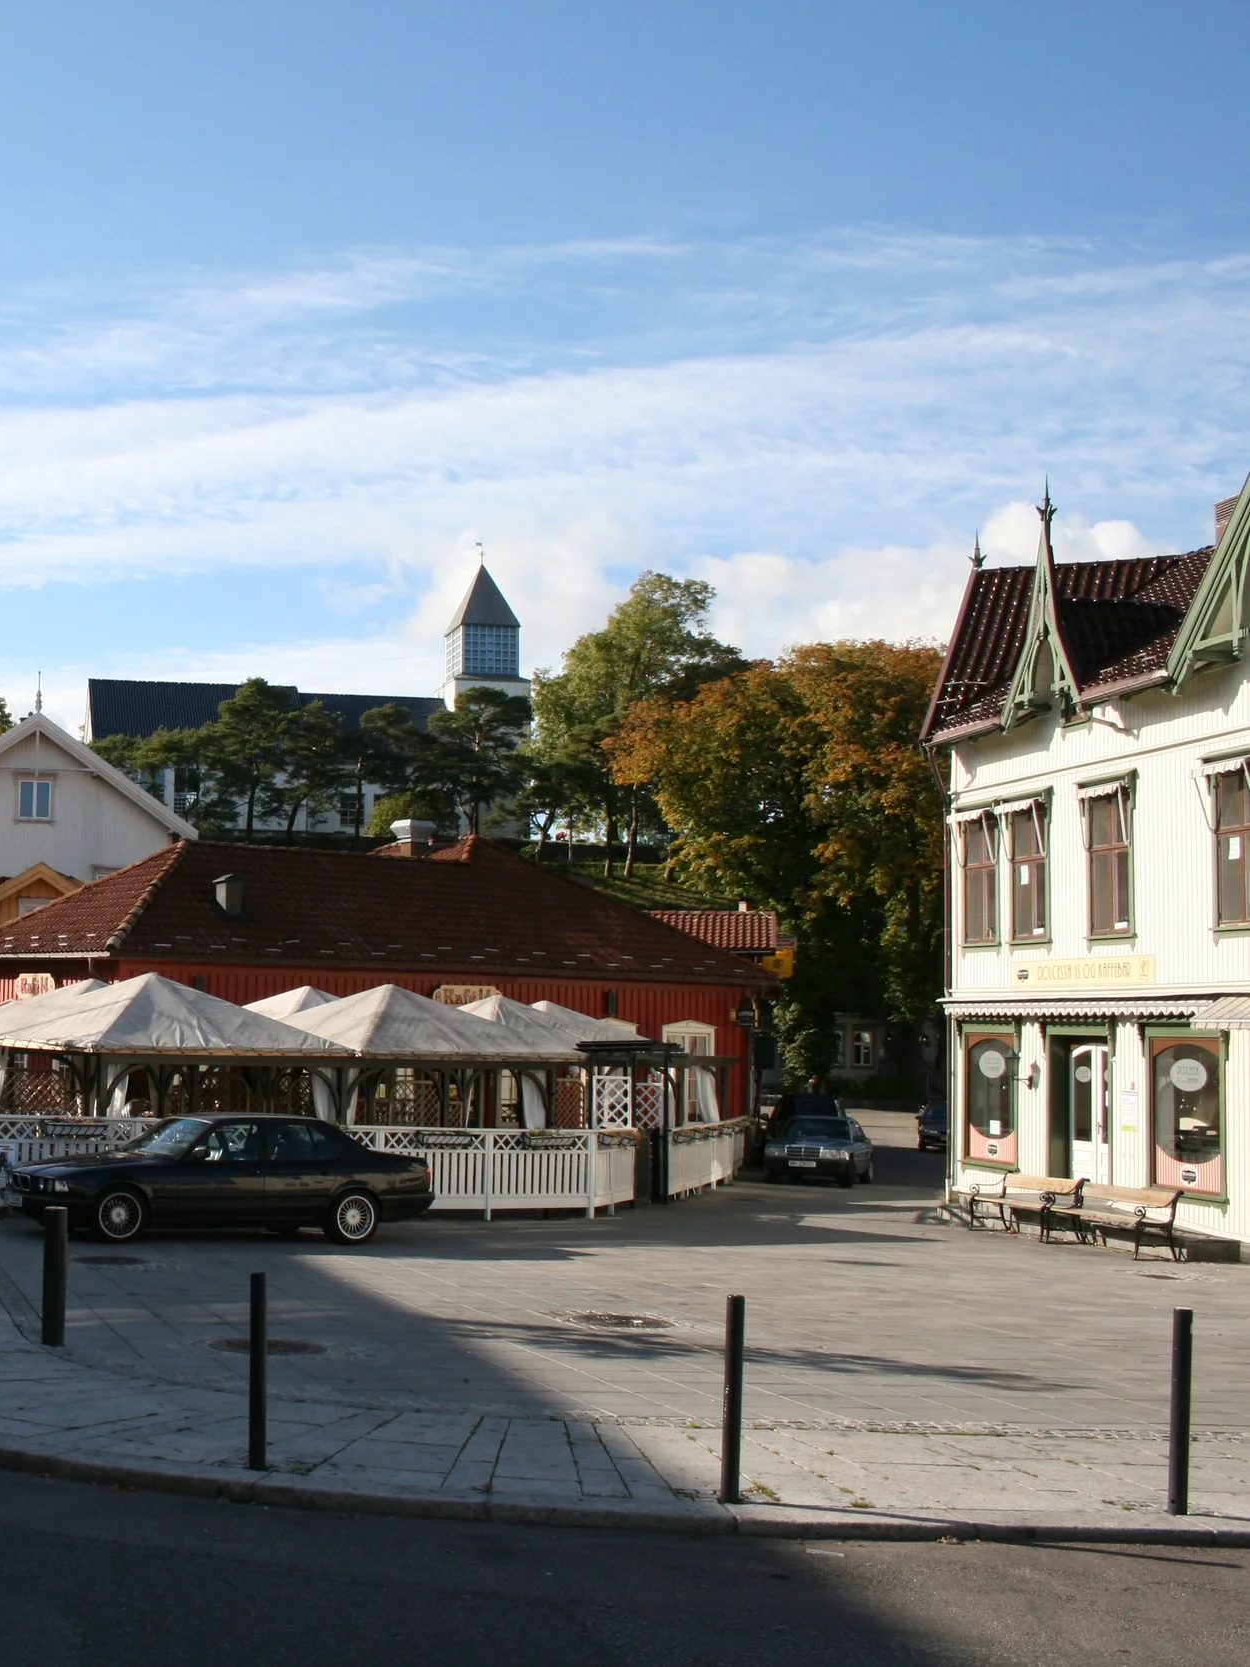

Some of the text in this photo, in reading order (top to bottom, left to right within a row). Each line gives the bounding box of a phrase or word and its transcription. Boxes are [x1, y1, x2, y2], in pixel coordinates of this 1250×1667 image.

[1037, 964, 1072, 981] DOLCESSA
[1074, 964, 1081, 979] IS
[1083, 963, 1096, 979] OG
[1098, 962, 1131, 978] KAFFEBAR
